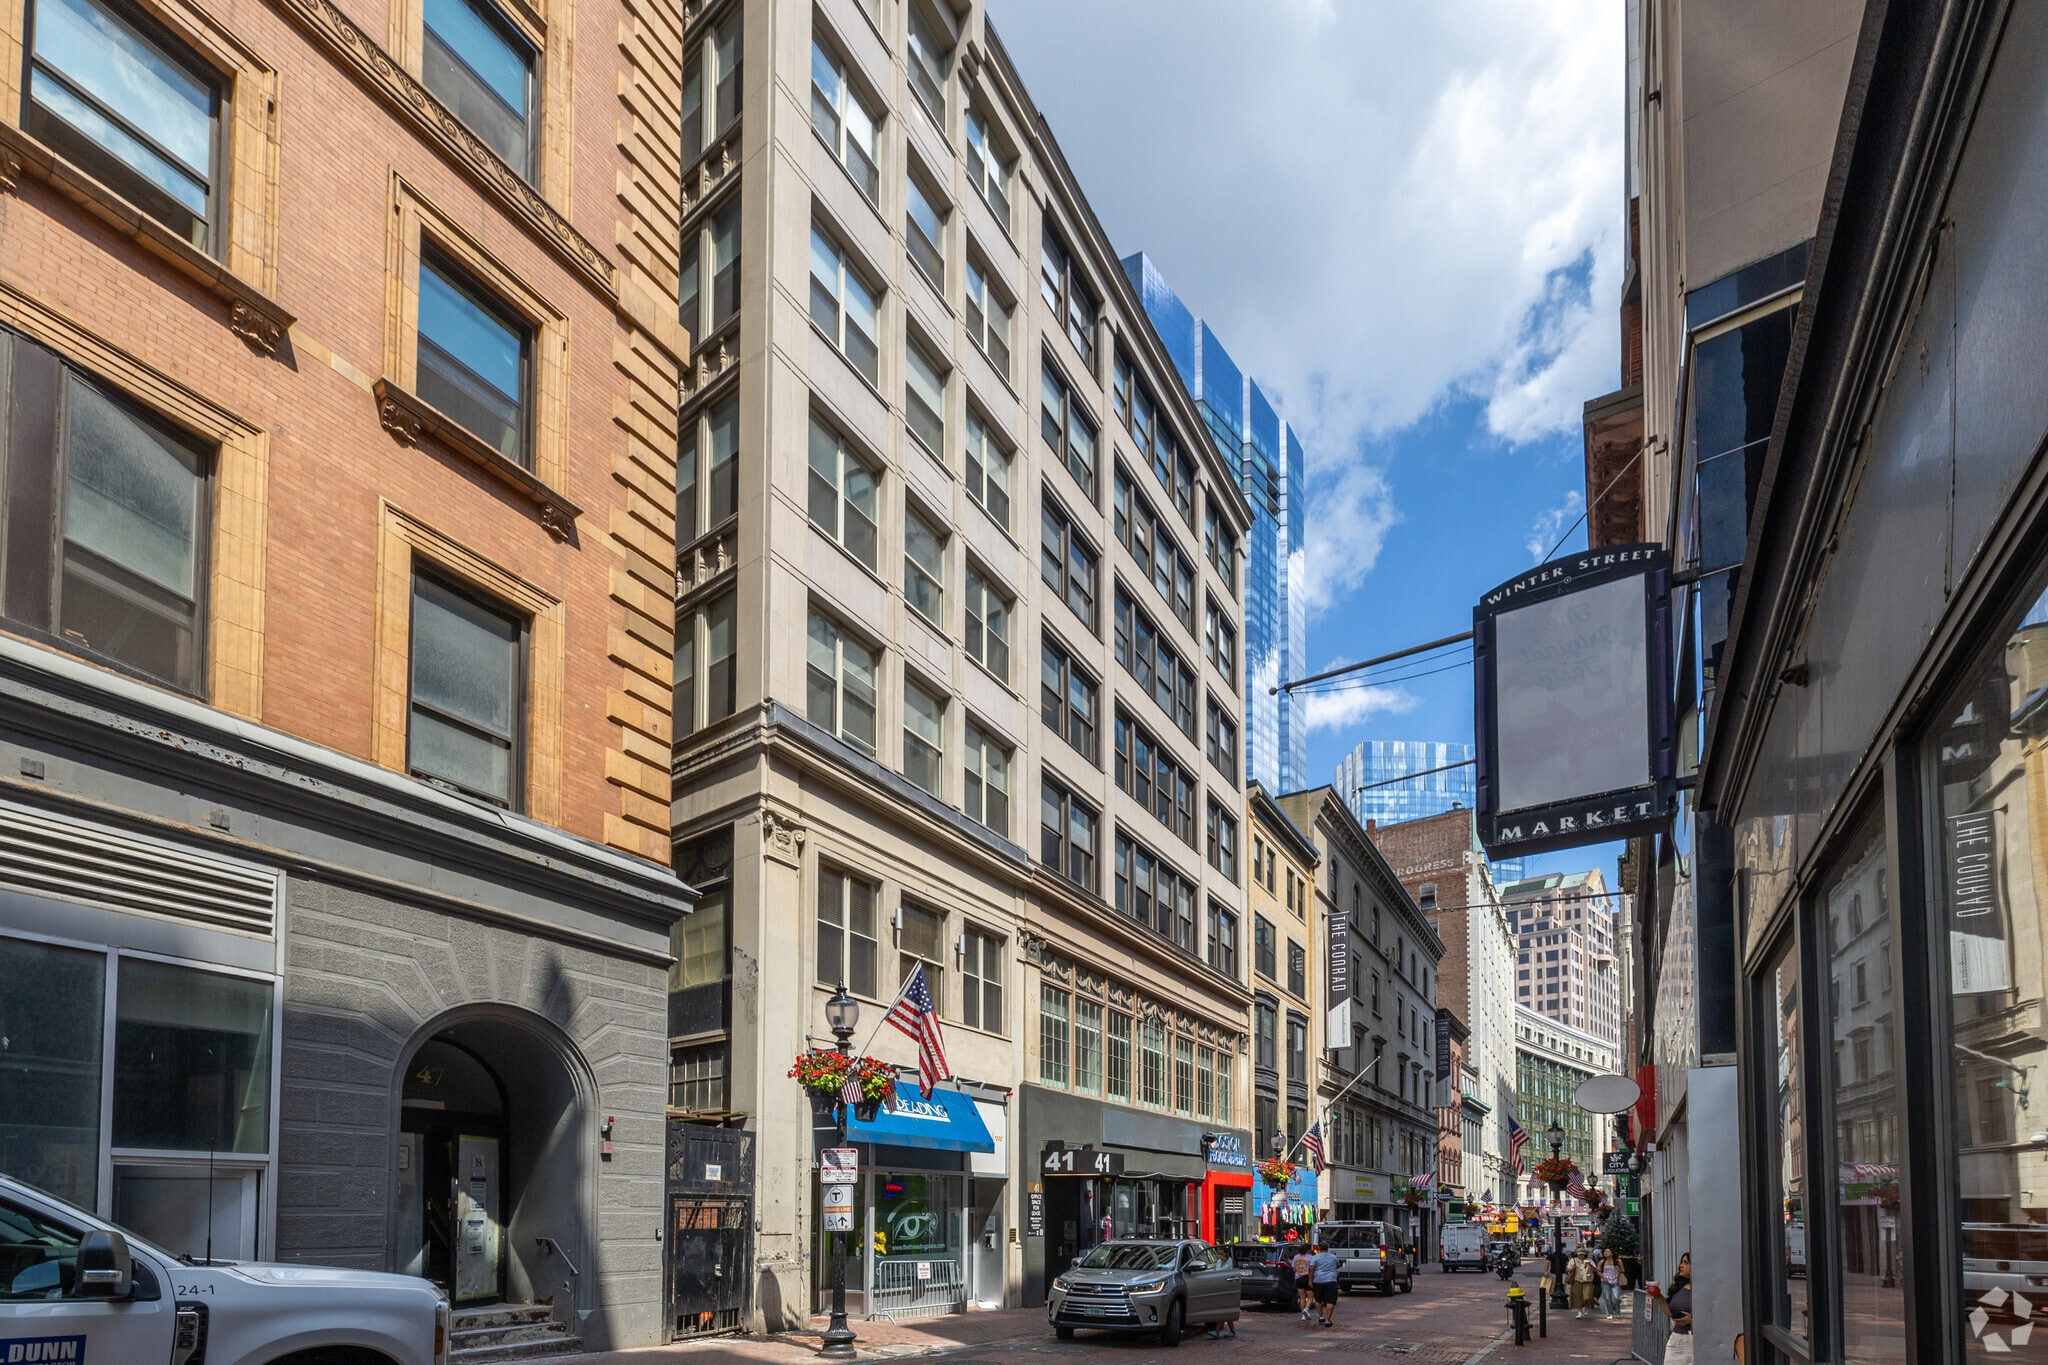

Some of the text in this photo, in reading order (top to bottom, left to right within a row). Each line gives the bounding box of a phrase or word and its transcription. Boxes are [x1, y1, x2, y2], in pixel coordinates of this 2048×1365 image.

[1487, 549, 1655, 605] WINTER STREET
[1501, 802, 1652, 840] MARKET
[1331, 914, 1347, 992] THE CONRAD
[1437, 1021, 1448, 1036] THE
[1438, 1040, 1449, 1071] CONRAD
[416, 1065, 445, 1086] 47
[881, 1098, 948, 1118] READING
[1045, 1151, 1074, 1171] 41
[1095, 1153, 1110, 1173] 41
[178, 1285, 214, 1296] 24-1
[8, 1341, 77, 1363] DUNN
